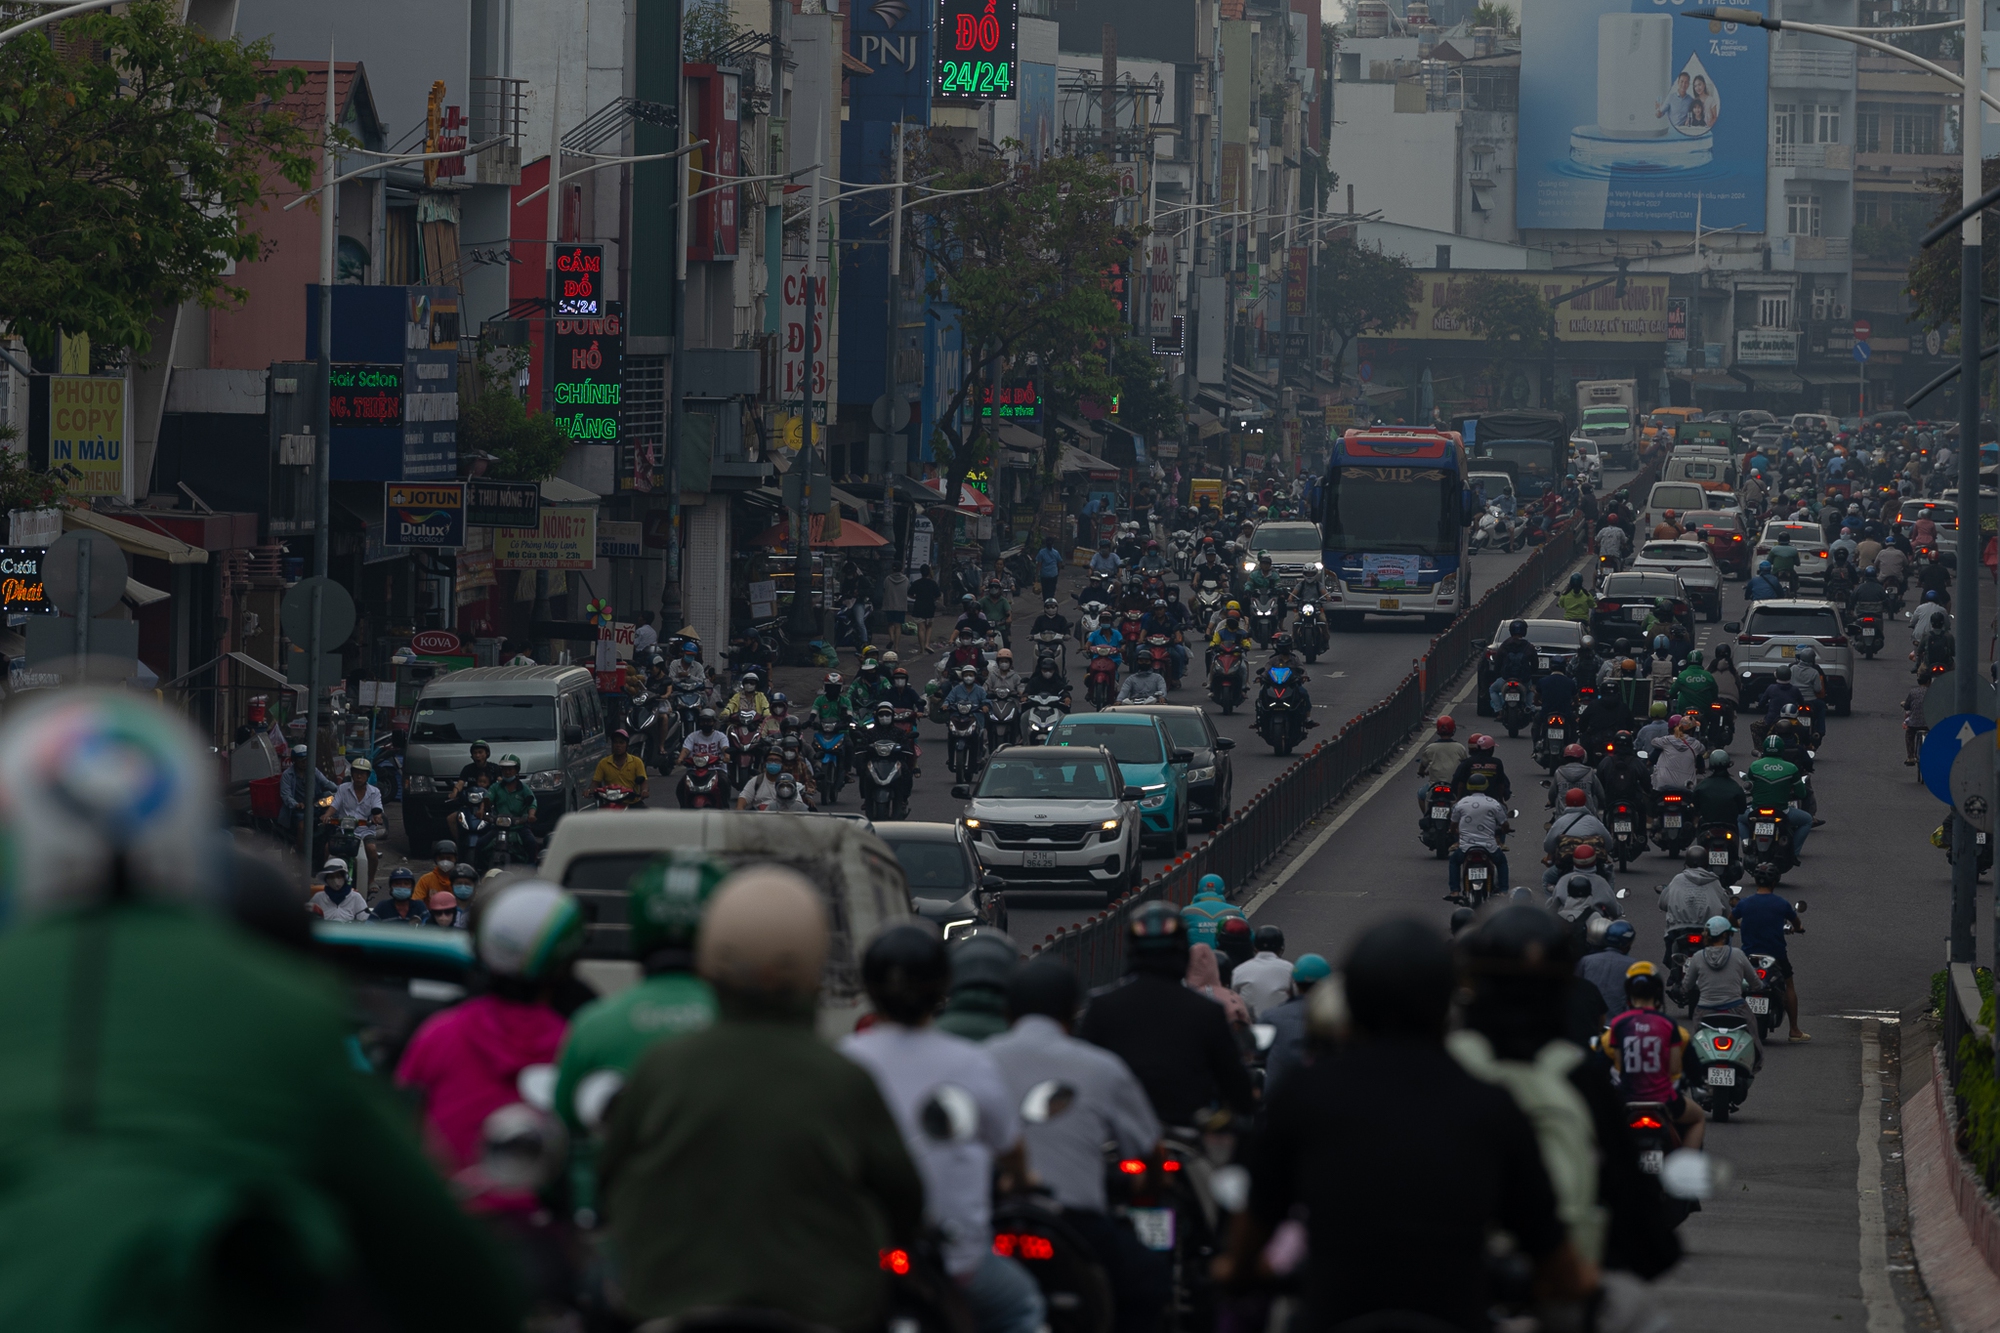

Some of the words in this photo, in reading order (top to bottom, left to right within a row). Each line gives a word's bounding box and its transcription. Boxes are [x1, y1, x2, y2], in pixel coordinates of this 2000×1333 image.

[956, 0, 1000, 52] ĐỒ
[860, 36, 918, 73] PNJ
[943, 61, 1009, 92] 24/24
[556, 248, 601, 273] CẦM
[563, 273, 592, 297] ĐỒ
[784, 264, 827, 306] CẦM
[1621, 278, 1650, 311] CÔNG
[1651, 286, 1666, 311] TY
[1151, 299, 1166, 321] ÂY
[1570, 316, 1593, 332] KHÚC
[1622, 317, 1648, 336] THUẬT
[1650, 320, 1667, 333] CAO
[1668, 325, 1685, 339] KÍNH
[572, 340, 602, 370] HỒ
[358, 370, 398, 388] Salon
[784, 360, 825, 394] 123
[54, 381, 121, 405] PHOTO
[554, 378, 620, 405] CHÍNH
[1014, 380, 1036, 405] ĐỒ
[353, 390, 399, 423] THIỆN
[56, 408, 117, 432] COPY
[555, 412, 617, 440] HÃNG
[54, 440, 72, 460] IN
[78, 435, 120, 461] MÀU
[84, 471, 120, 491] MENU
[1376, 468, 1412, 481] VIP
[408, 492, 458, 504] JOTUN
[478, 488, 498, 506] THUI
[500, 486, 523, 508] NÓNG
[524, 491, 535, 508] 77
[400, 522, 444, 536] Dulux
[543, 511, 572, 539] NÓNG
[573, 517, 587, 538] 77
[418, 535, 445, 543] colour
[510, 540, 519, 549] Có
[520, 540, 542, 550] Phòng
[543, 541, 558, 551] Máy
[560, 541, 577, 551] Lạnh
[601, 542, 639, 556] SUBIN
[507, 550, 520, 558] Mở
[522, 550, 537, 559] Cửa
[539, 551, 558, 559] 8h30
[1, 557, 37, 575] Cưới
[2, 577, 43, 605] Phát
[420, 637, 452, 648] KOVA
[615, 624, 636, 645] TẮC
[1686, 675, 1707, 683] Grab
[1763, 764, 1784, 772] Grab
[1032, 852, 1047, 860] 51H
[1623, 1035, 1662, 1073] 83
[1711, 1069, 1731, 1077] 59-T2
